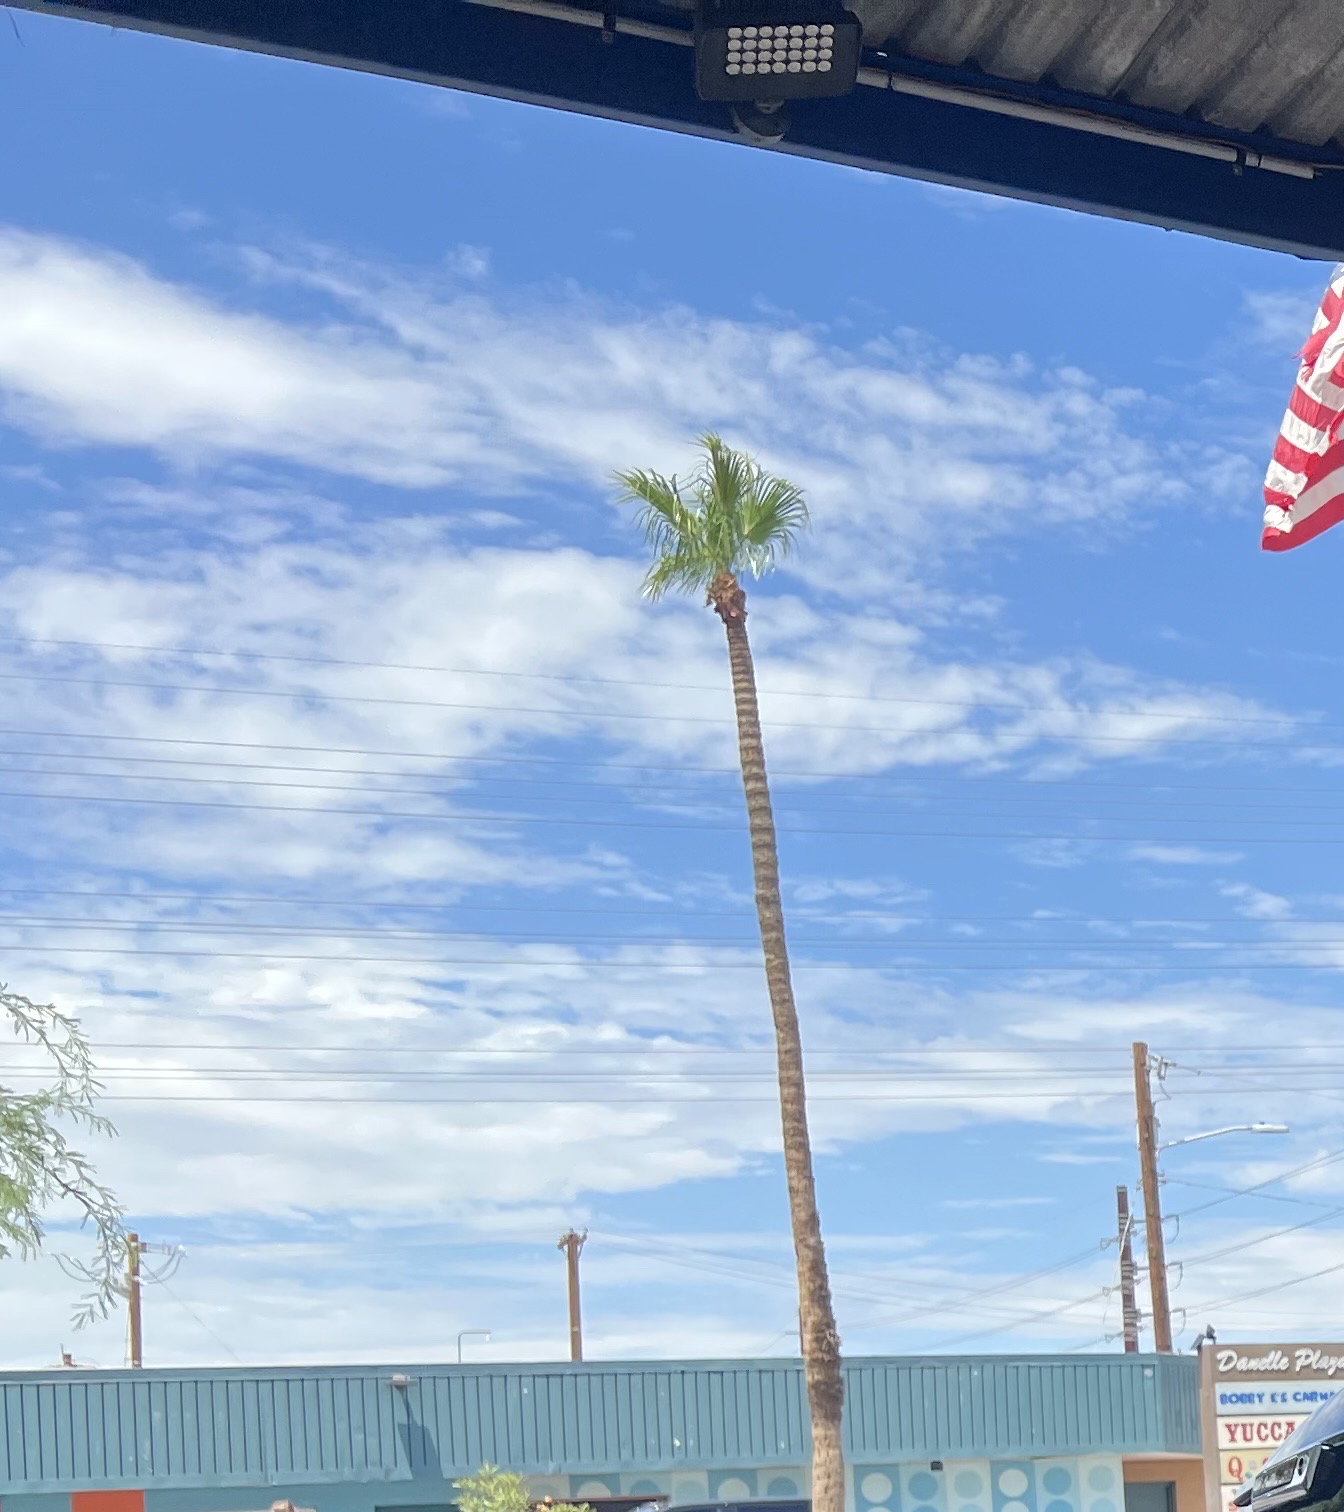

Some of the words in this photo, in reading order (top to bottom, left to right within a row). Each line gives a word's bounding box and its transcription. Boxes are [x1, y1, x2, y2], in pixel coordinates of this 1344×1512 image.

[1216, 1349, 1290, 1373] Danelle
[1219, 1392, 1265, 1405] BOBBY
[1225, 1421, 1296, 1443] YUCCA
